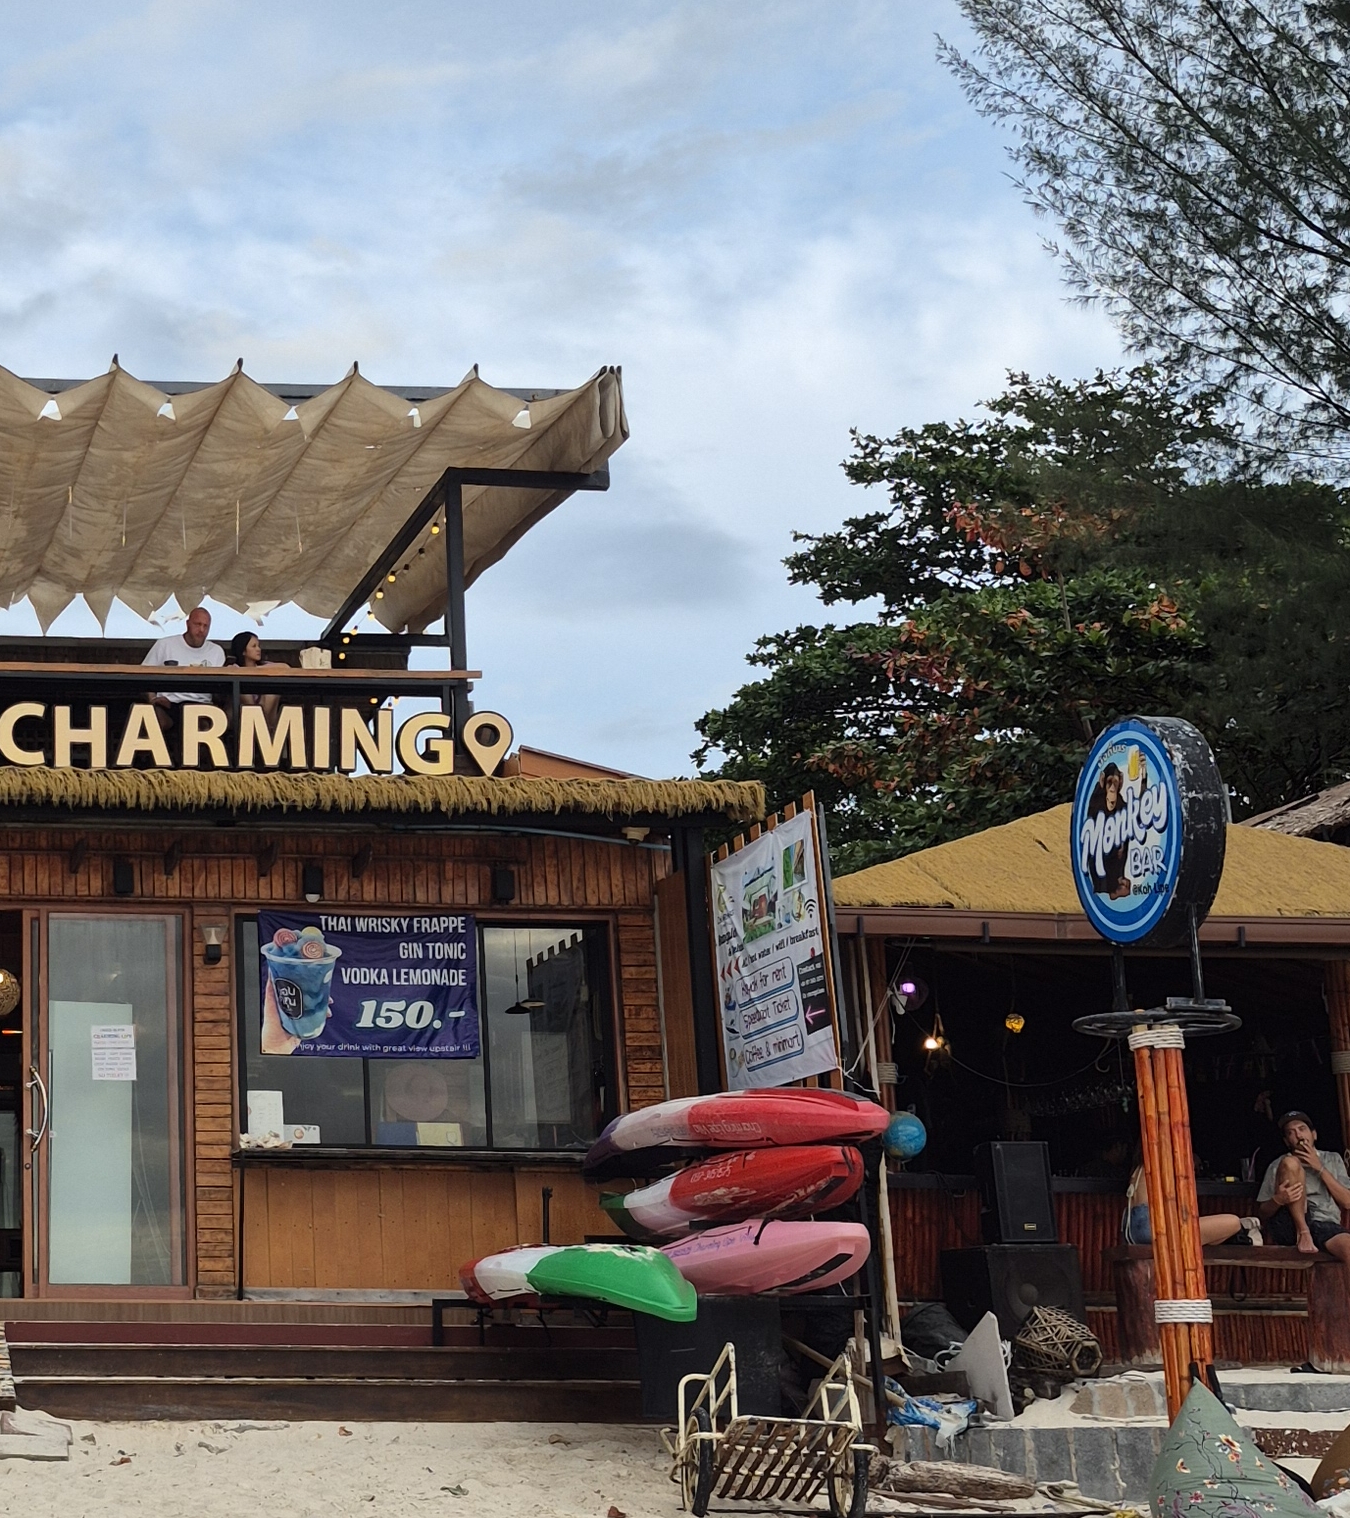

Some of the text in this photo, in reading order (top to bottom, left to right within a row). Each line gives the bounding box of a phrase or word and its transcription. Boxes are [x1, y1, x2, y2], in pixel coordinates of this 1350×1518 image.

[1080, 781, 1168, 876] Monkey
[1129, 845, 1167, 877] BAR
[319, 915, 466, 934] THAI WRISKY FRAPPE
[790, 926, 819, 944] breakfast
[399, 942, 466, 960] GIN TONIC
[341, 967, 467, 986] VODKA LEMONADE
[759, 970, 769, 987] for
[772, 962, 787, 983] rent
[355, 999, 466, 1029] 150.-
[772, 998, 791, 1014] Ticket
[316, 1043, 335, 1051] your
[337, 1043, 360, 1051] drink
[362, 1043, 381, 1051] with
[382, 1044, 407, 1053] great
[429, 1044, 460, 1053] upstair
[745, 1044, 764, 1063] Coffee
